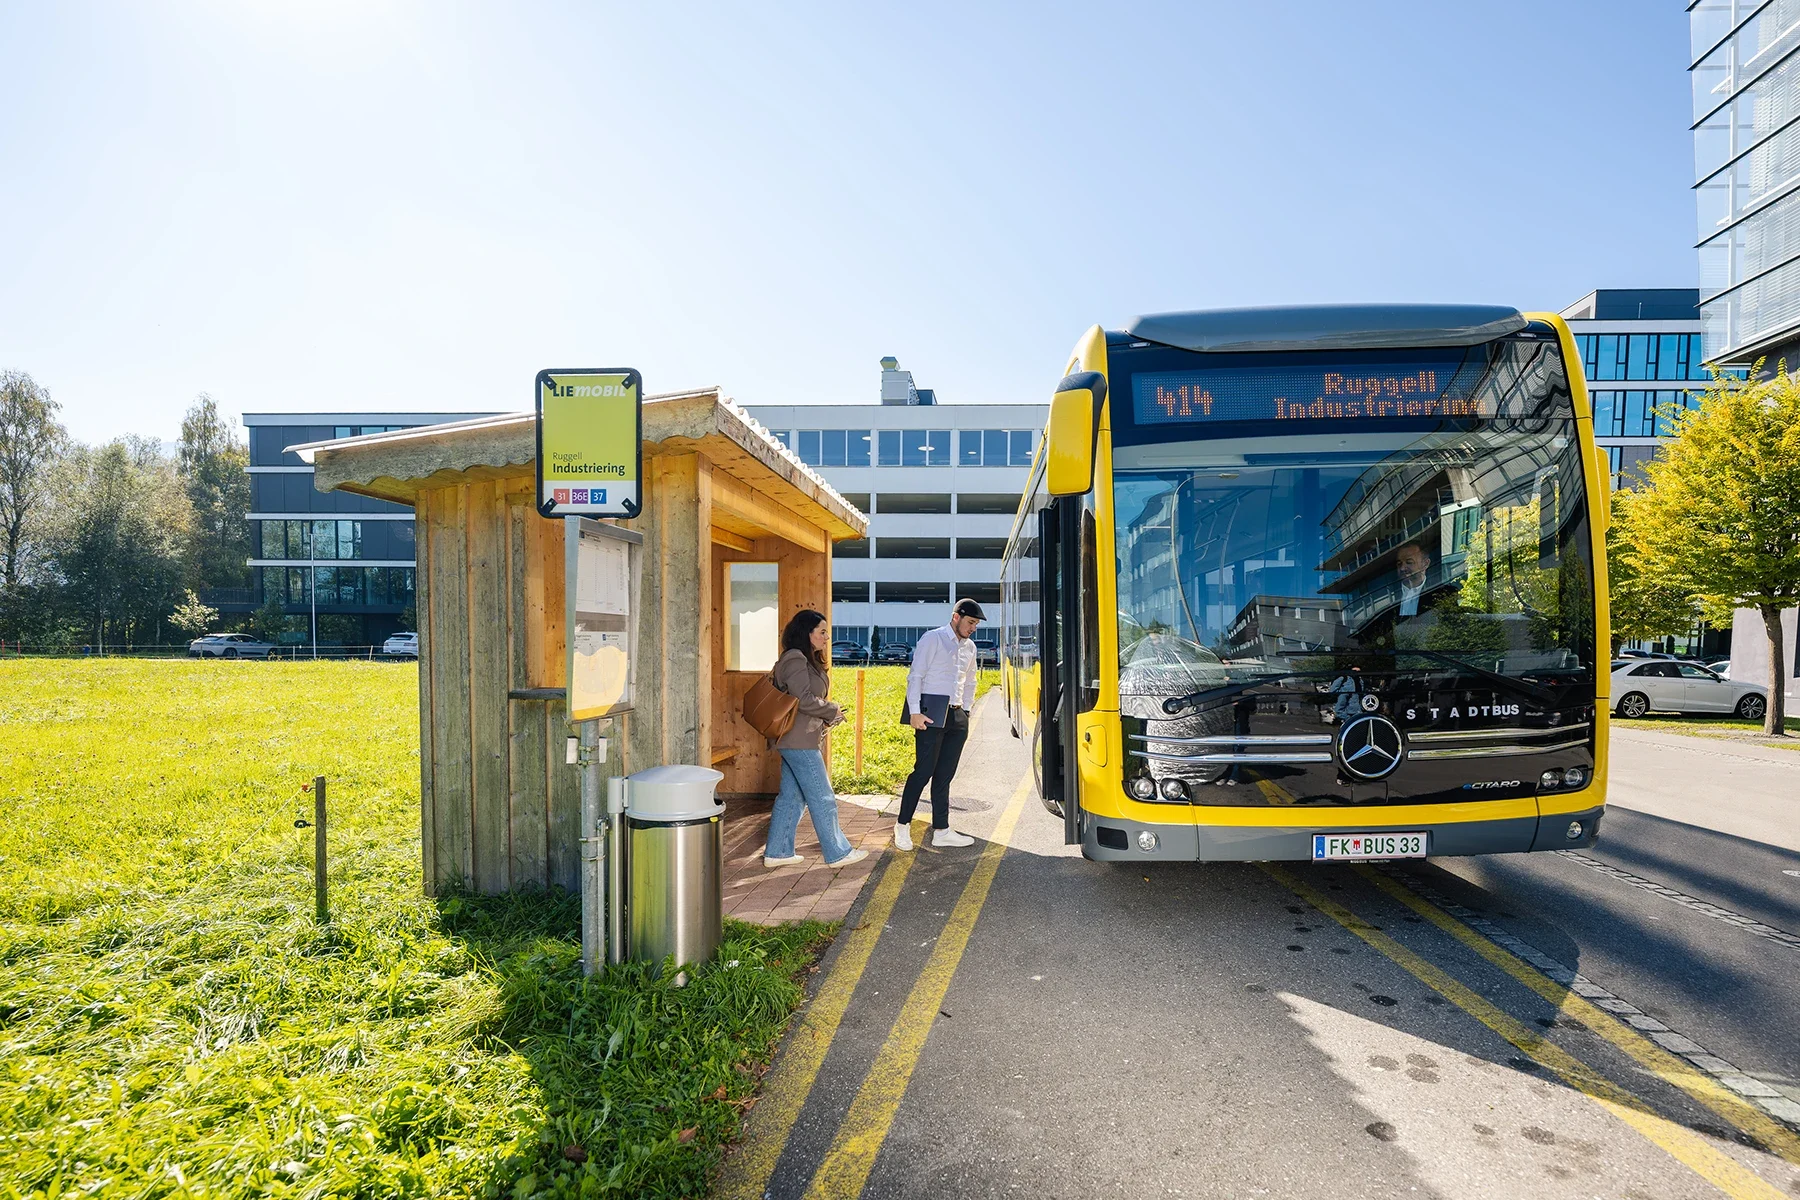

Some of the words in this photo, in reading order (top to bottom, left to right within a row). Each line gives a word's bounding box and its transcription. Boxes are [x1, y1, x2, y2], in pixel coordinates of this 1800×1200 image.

[1323, 370, 1436, 396] Ruggell
[1156, 385, 1213, 416] 414
[553, 452, 582, 462] Ruggell
[553, 463, 625, 476] Industriering
[558, 492, 566, 501] 31
[573, 491, 588, 501] 36E
[593, 492, 604, 502] 37
[1330, 839, 1350, 855] FK
[1364, 838, 1395, 854] BUS
[1400, 837, 1420, 853] 33
